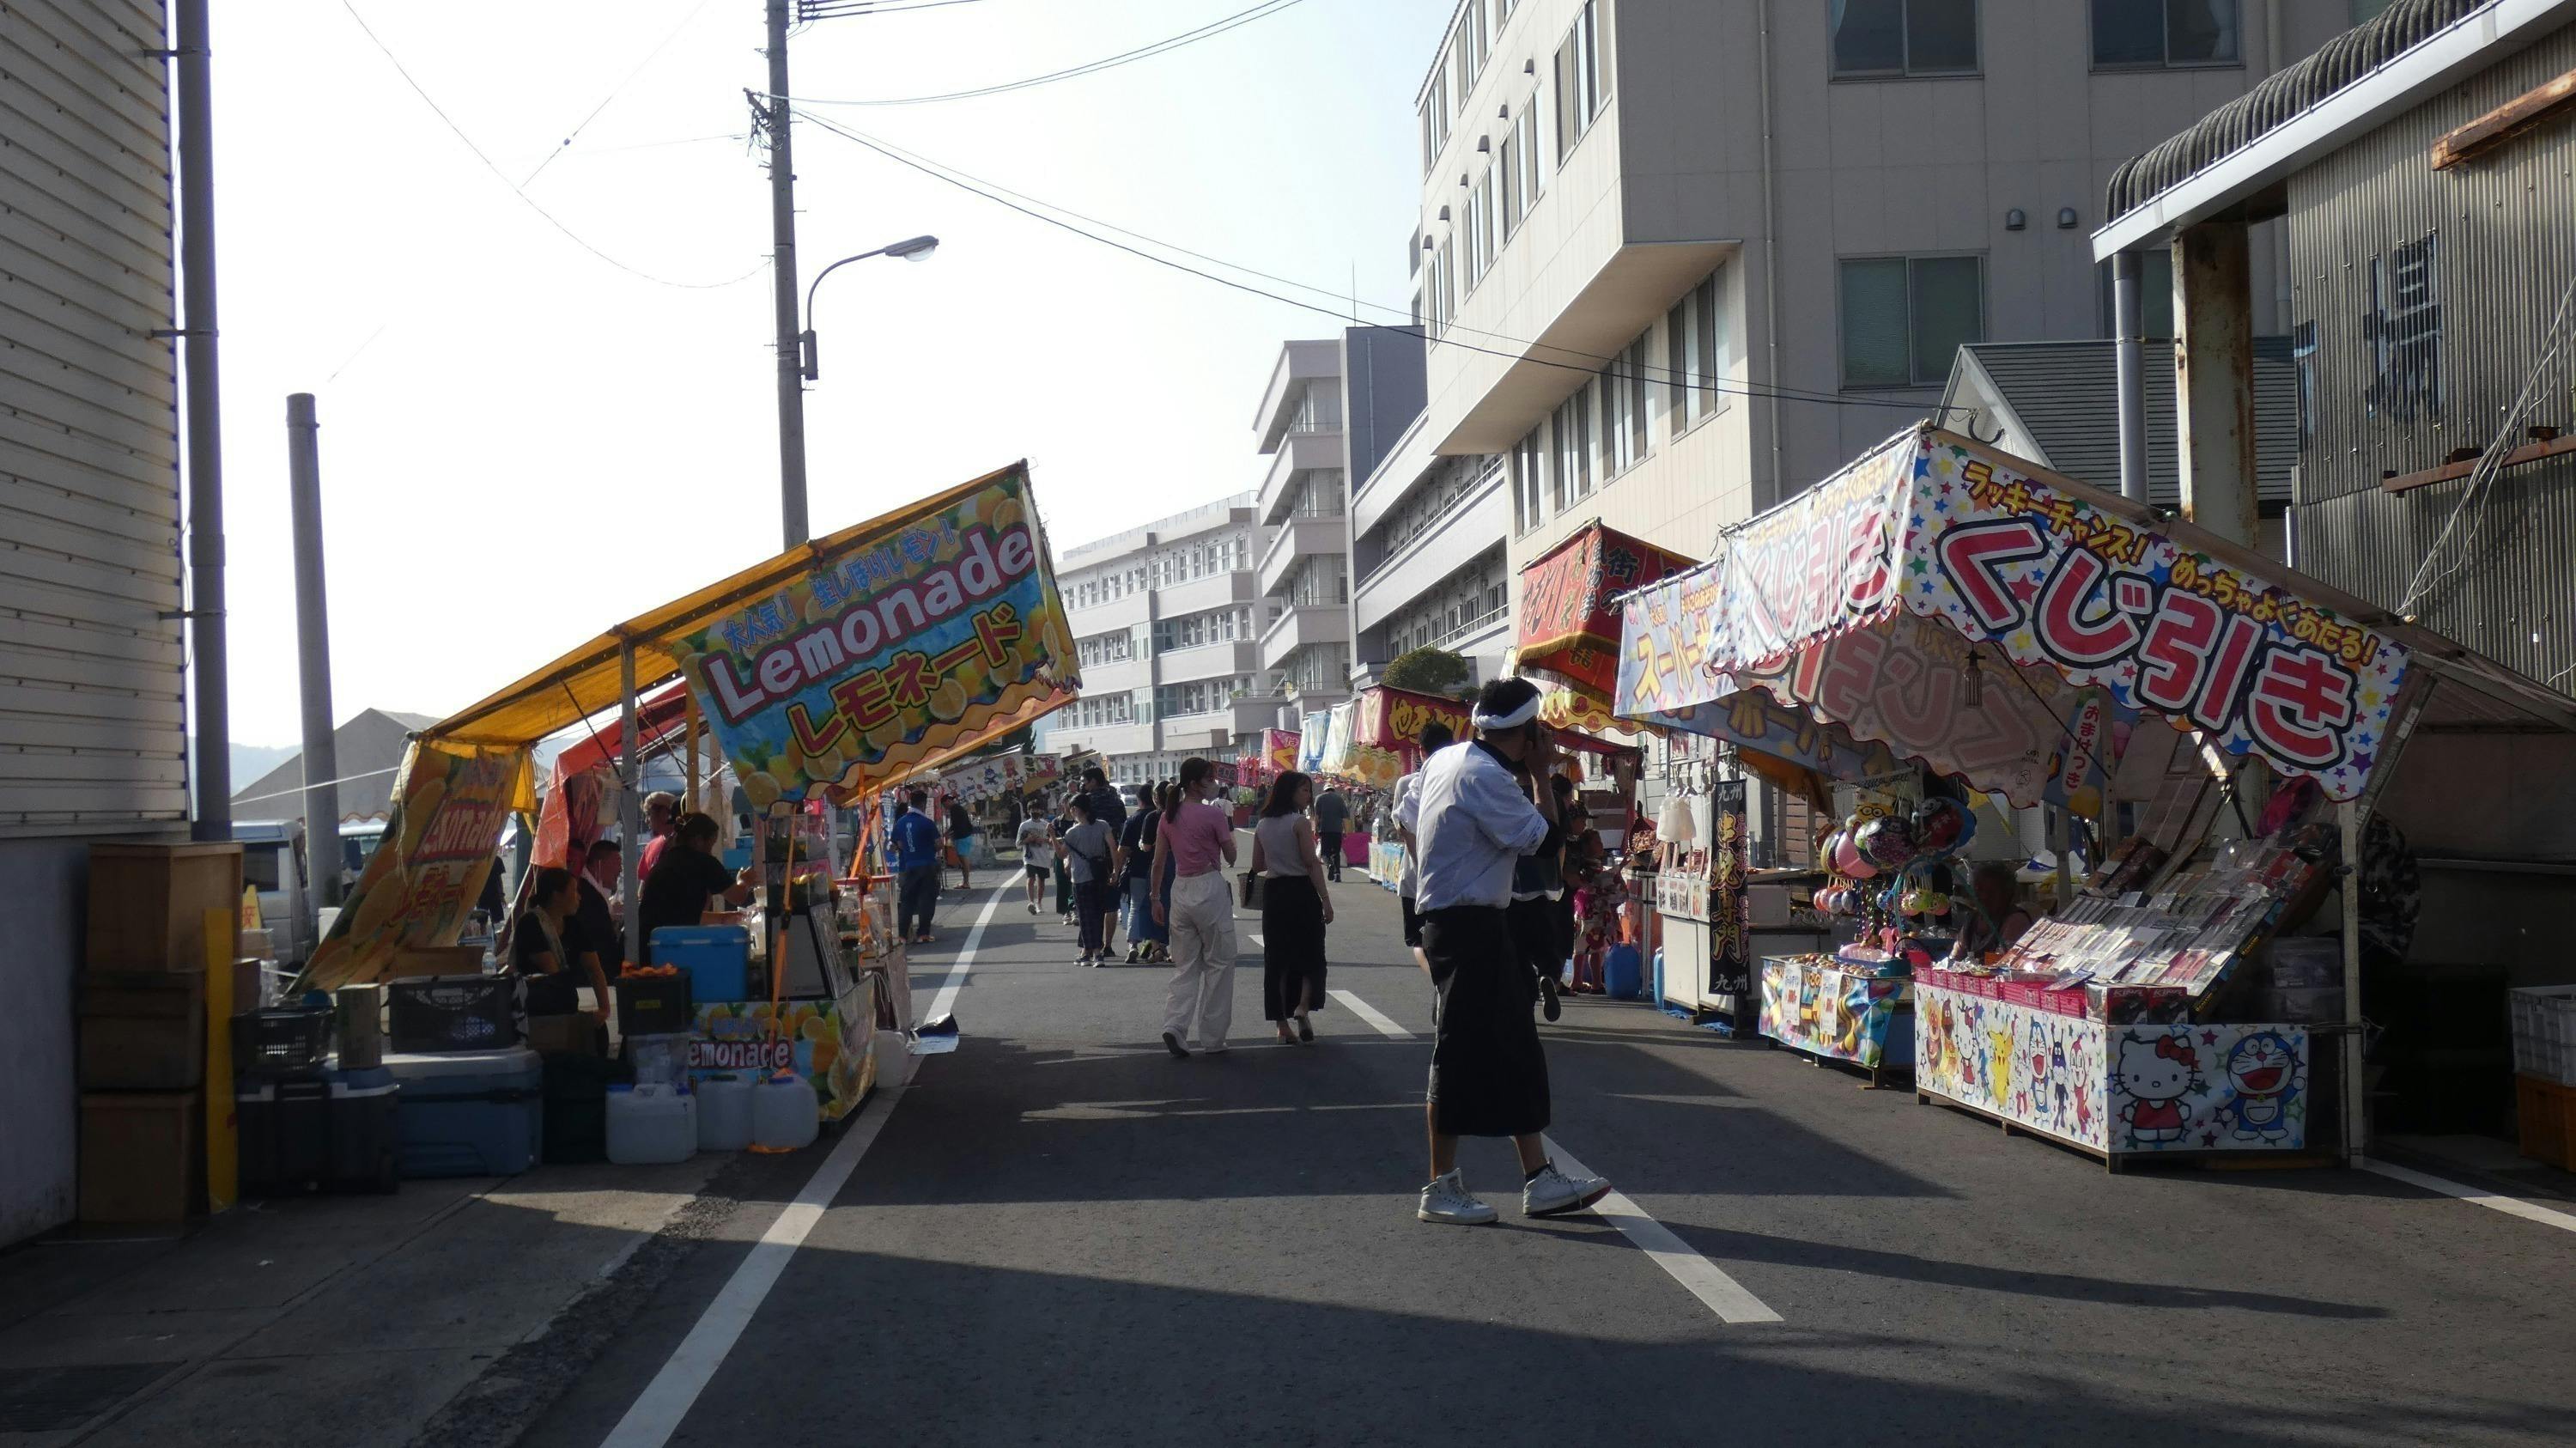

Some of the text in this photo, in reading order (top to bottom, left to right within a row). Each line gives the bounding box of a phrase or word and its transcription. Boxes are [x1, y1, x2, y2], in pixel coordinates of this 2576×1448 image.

[708, 529, 1034, 719] Lemonade
[1748, 500, 1891, 646] くじ引き
[1961, 458, 2150, 566] ラッキーチャンス!
[2170, 552, 2379, 666] めっちゃよくあたる!
[787, 602, 1021, 758] レモネード
[1937, 517, 2356, 770] くじ引き
[1717, 784, 1743, 803] 九州
[688, 1041, 792, 1068] emonade
[1714, 973, 1747, 991] 九州
